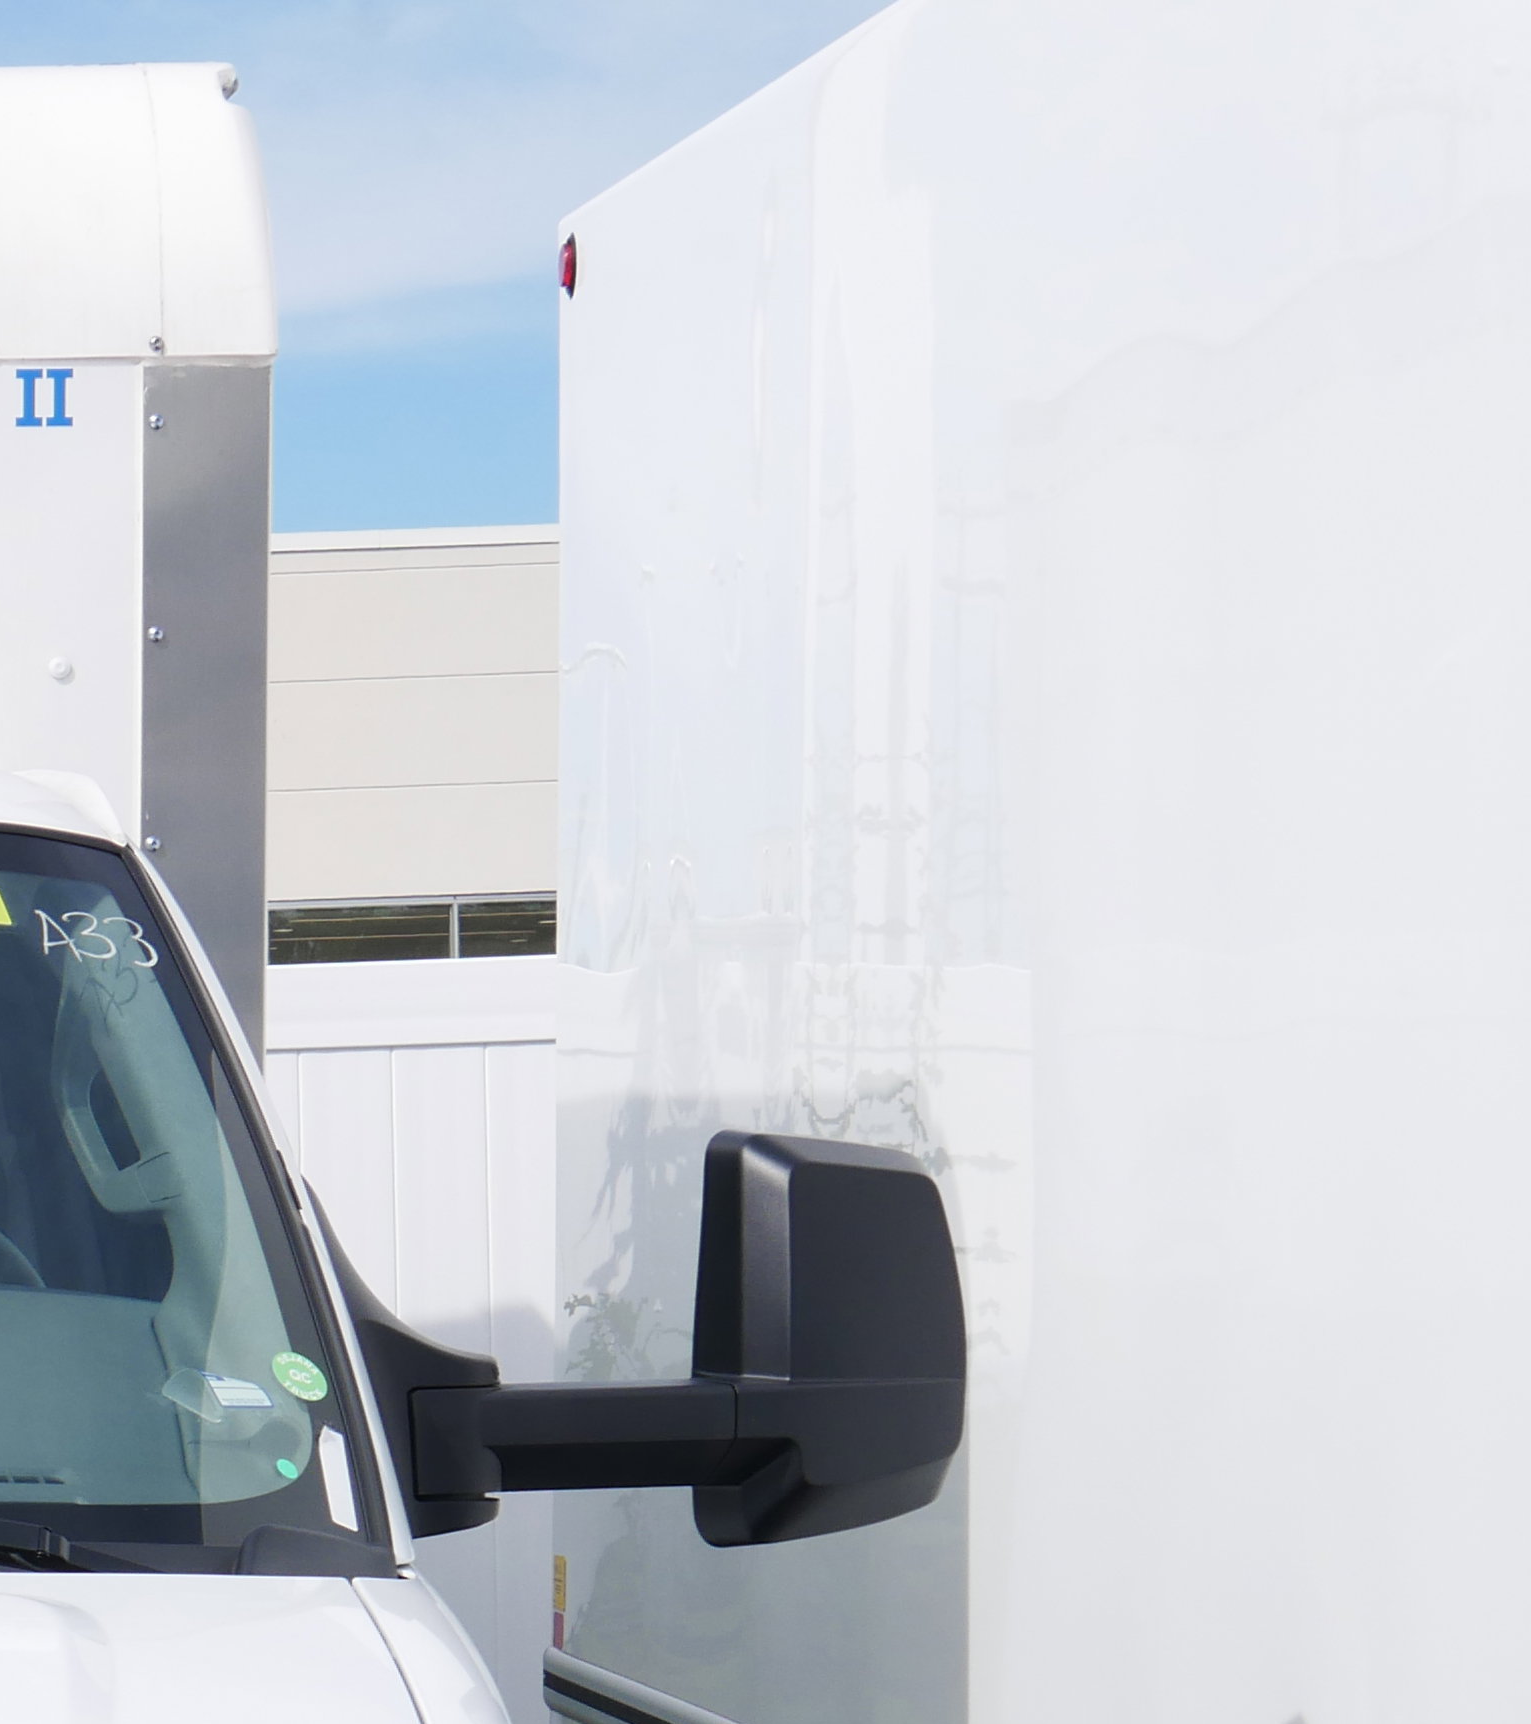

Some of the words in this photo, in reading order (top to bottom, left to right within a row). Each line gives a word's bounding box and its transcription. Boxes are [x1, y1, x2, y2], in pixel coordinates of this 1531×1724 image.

[15, 368, 74, 427] II
[34, 909, 159, 968] A33
[288, 1369, 312, 1384] QC
